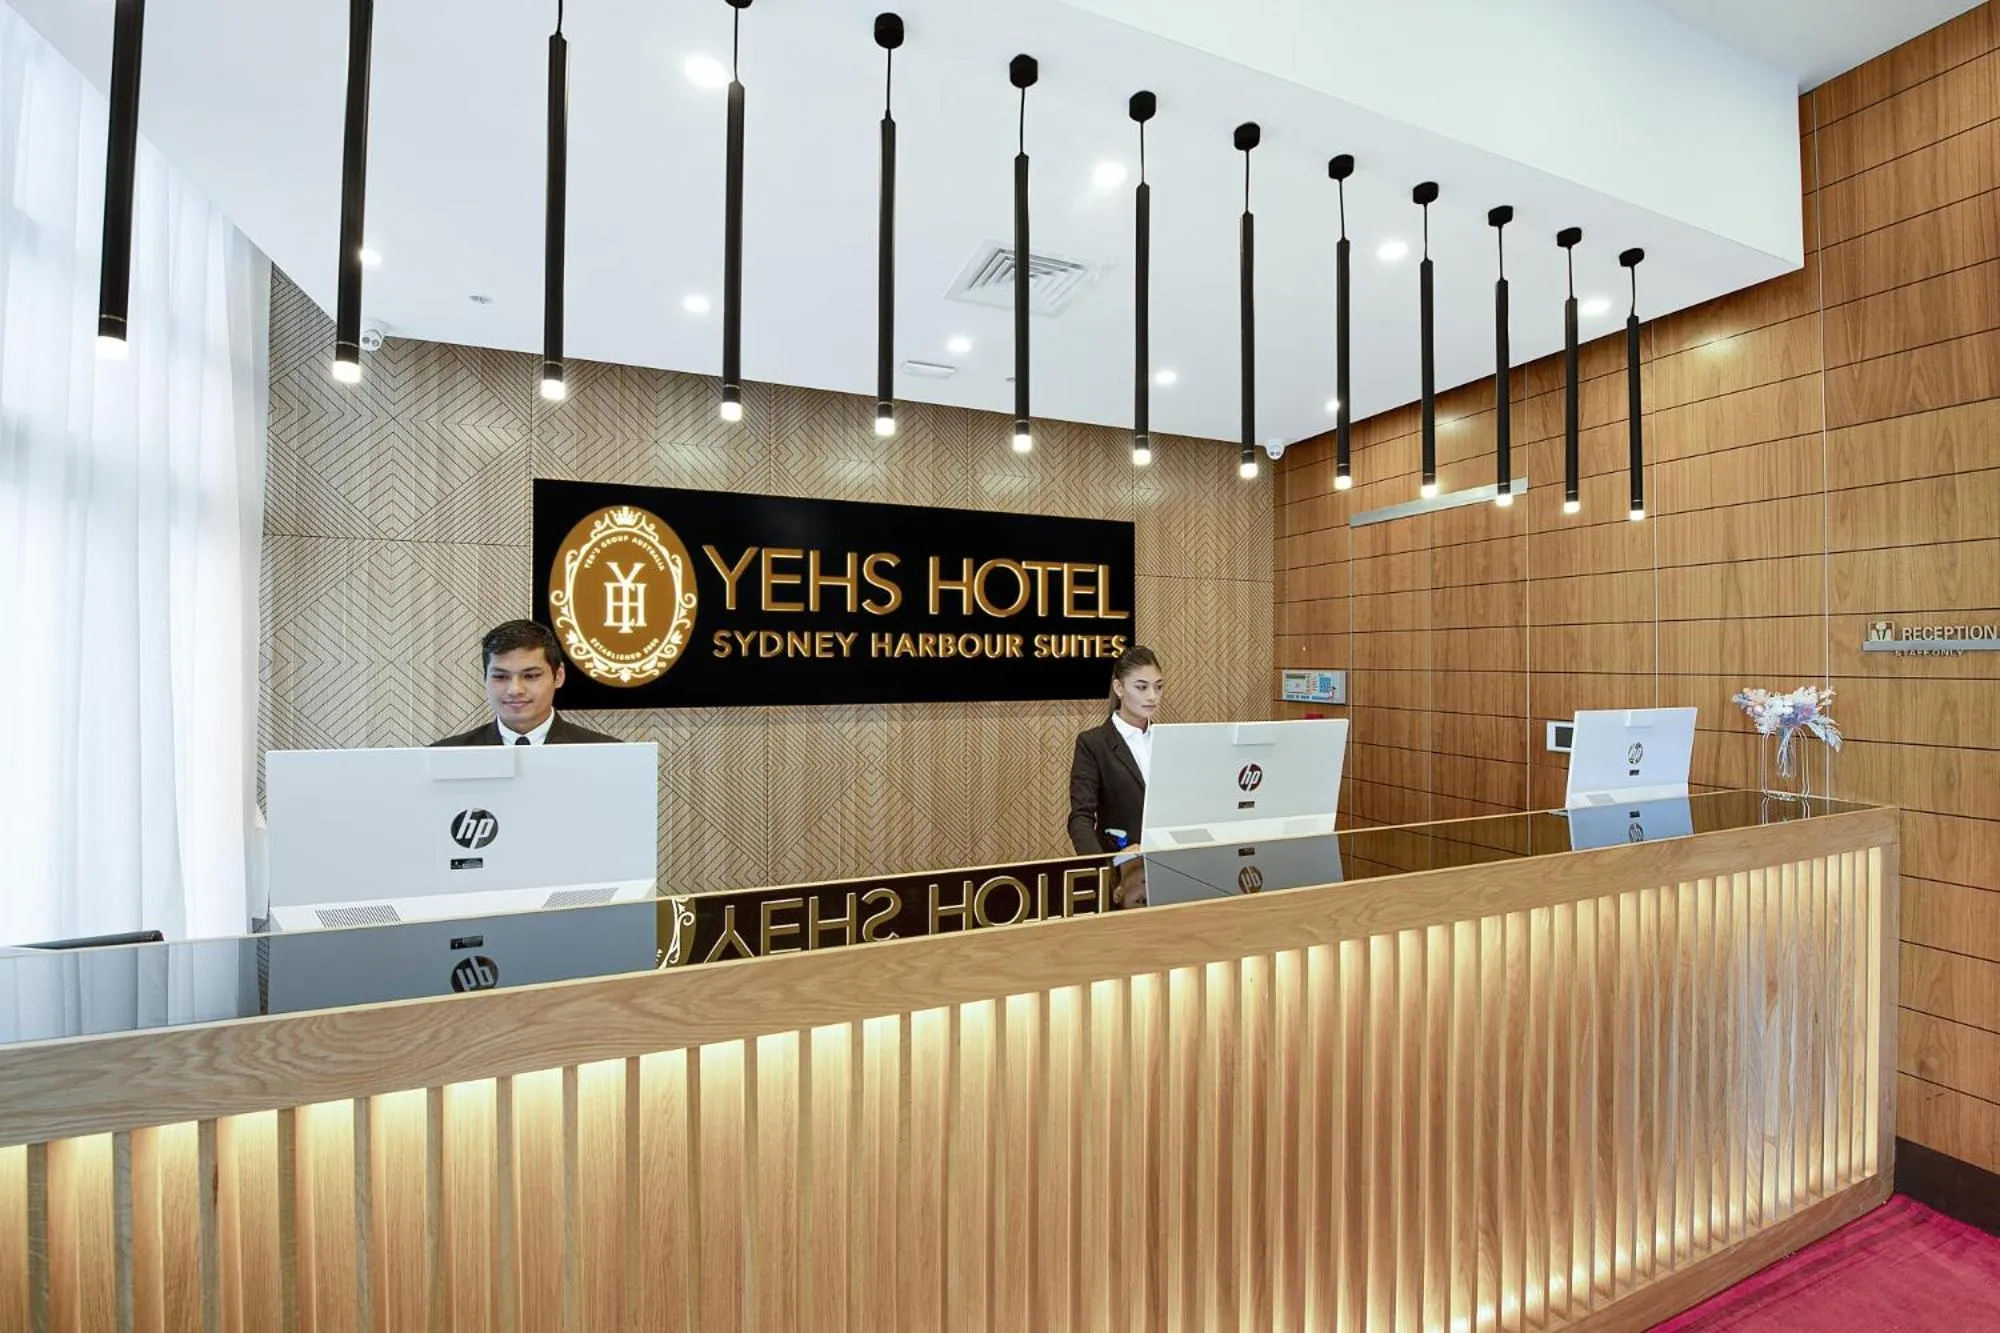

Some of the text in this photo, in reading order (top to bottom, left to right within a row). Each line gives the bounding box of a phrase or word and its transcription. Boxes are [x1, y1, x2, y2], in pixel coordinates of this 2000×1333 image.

[600, 534, 629, 549] GROUP
[702, 545, 1130, 620] YEHS HOTEL
[712, 630, 1127, 659] SYDNEY HARBOUR SUITES
[1901, 624, 1998, 641] RECEPTION
[1240, 764, 1262, 791] hp
[455, 809, 495, 849] hp
